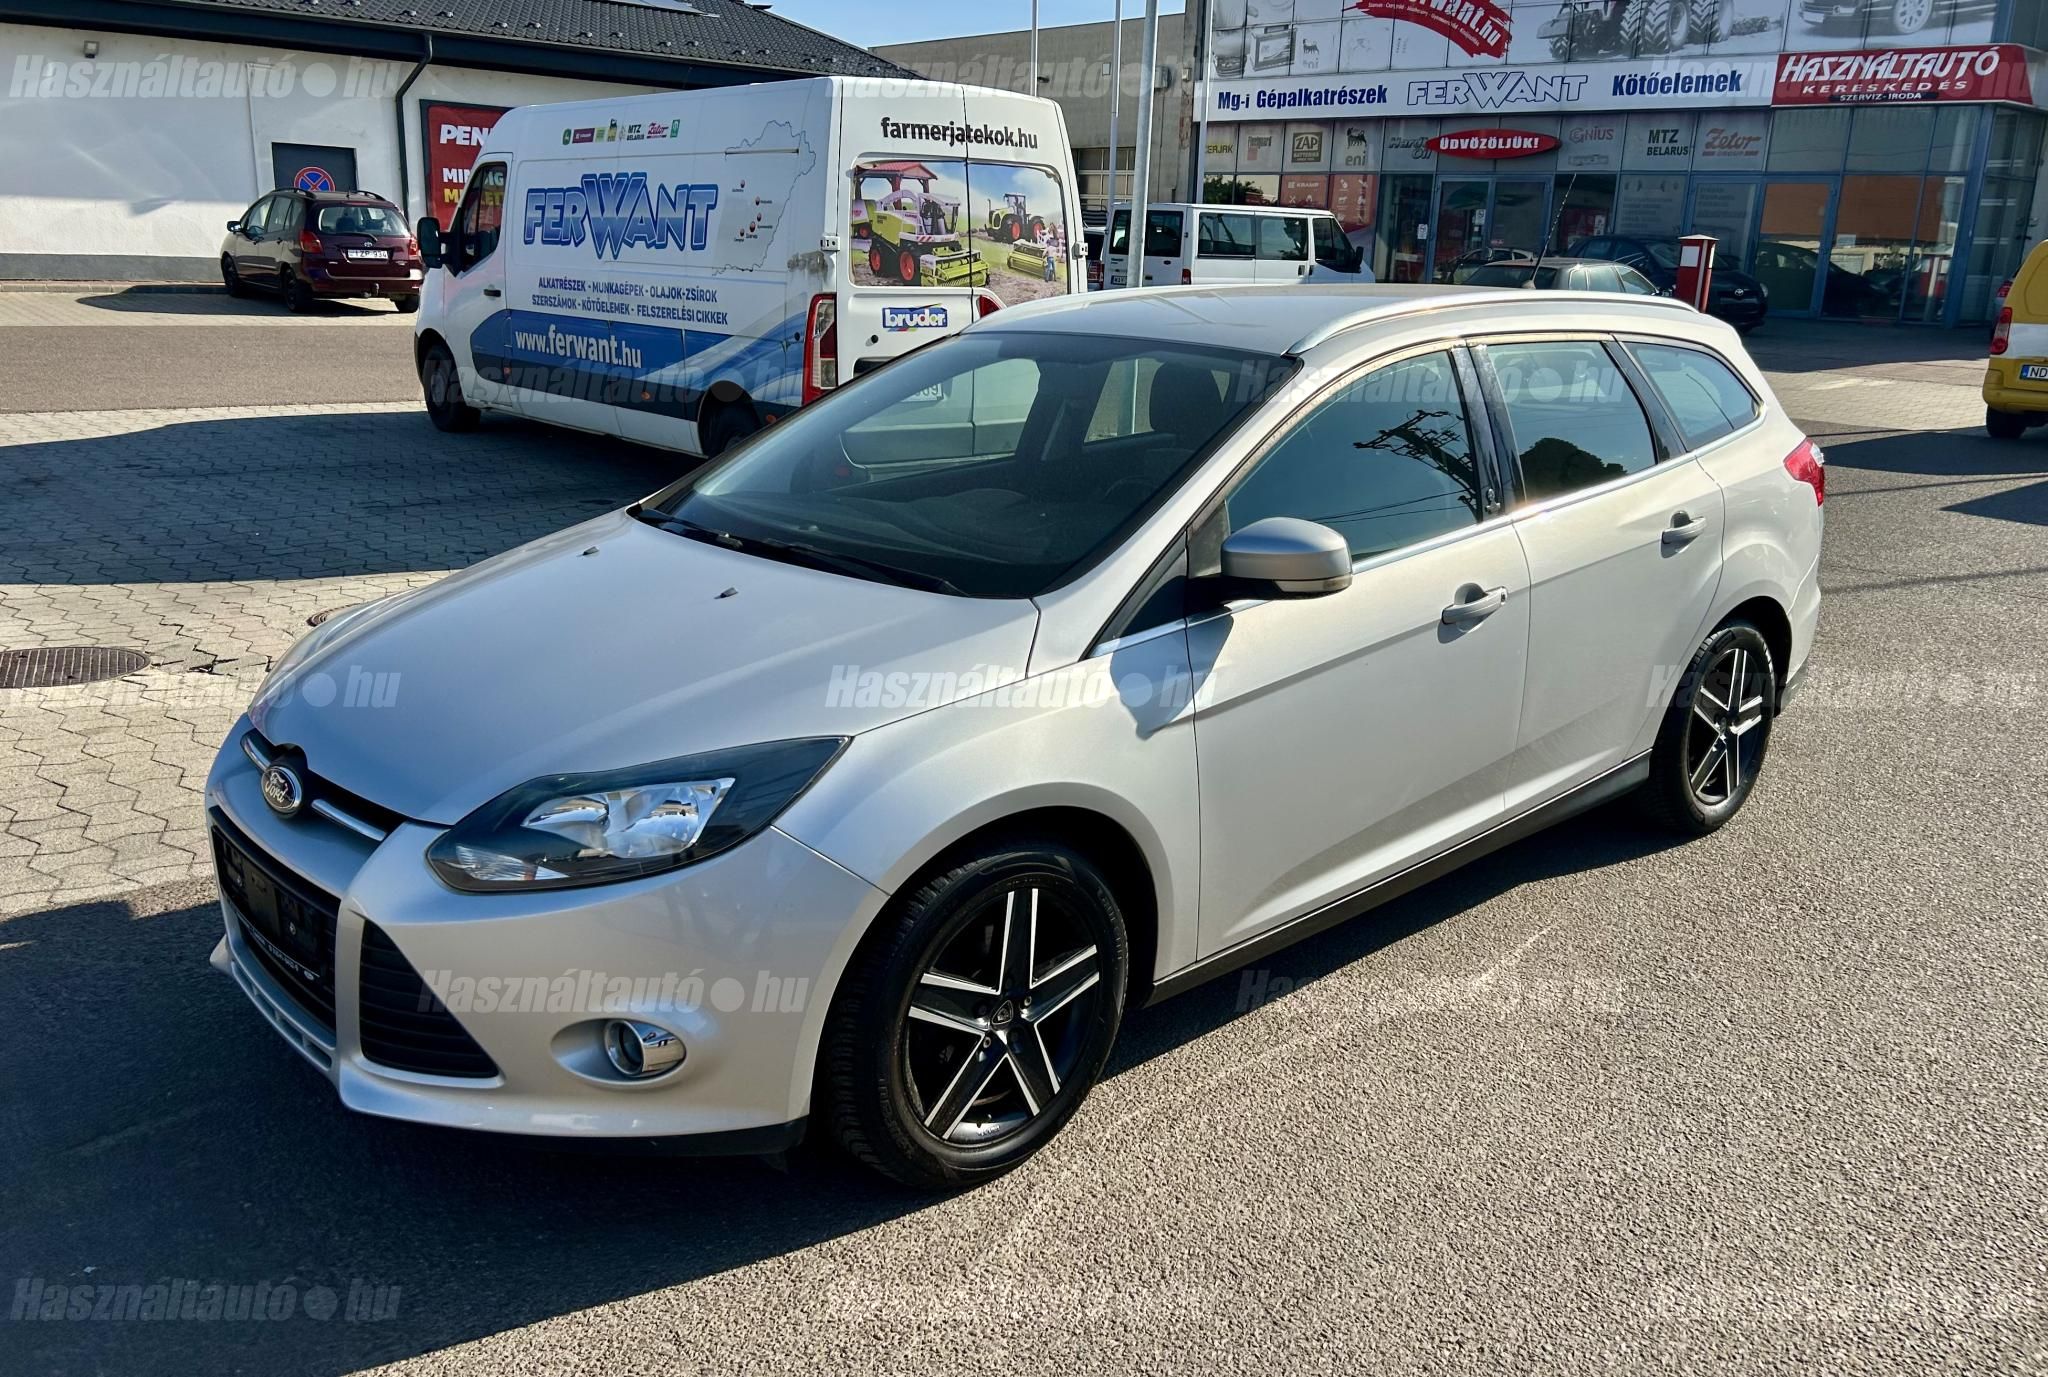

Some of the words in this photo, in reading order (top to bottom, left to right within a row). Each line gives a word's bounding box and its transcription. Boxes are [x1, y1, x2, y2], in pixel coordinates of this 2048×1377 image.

[1779, 46, 2000, 82] HASZNÁLTAUTÓ
[1218, 91, 1250, 111] Mg-i
[1256, 84, 1388, 110] Gépalkatrészek
[1612, 70, 1742, 96] Kötőelemek
[1802, 80, 1967, 94] KERESKEDÉS
[440, 124, 493, 146] PEN
[881, 117, 1038, 149] farmerjatekok.hu
[1296, 136, 1318, 150] ZAP
[1439, 135, 1539, 150] ÜDVÖZÖLJÜK!
[1648, 129, 1679, 144] MTZ
[1345, 151, 1366, 166] eni
[1646, 146, 1689, 156] BELARUS
[538, 276, 586, 292] ALKATRÉSZEK
[592, 281, 644, 297] MUNKAGÉPEK
[650, 284, 718, 302] OLAJOK-ZSÍROK
[532, 294, 577, 309] SZERSZÁMOK
[582, 298, 630, 316] KÖTŐELEMEK
[637, 304, 695, 322] FELSZERELÉSI
[696, 310, 728, 326] CIKKEK
[884, 308, 945, 328] bruder
[515, 324, 642, 369] www.ferwant.hu
[265, 772, 289, 803] Ford
